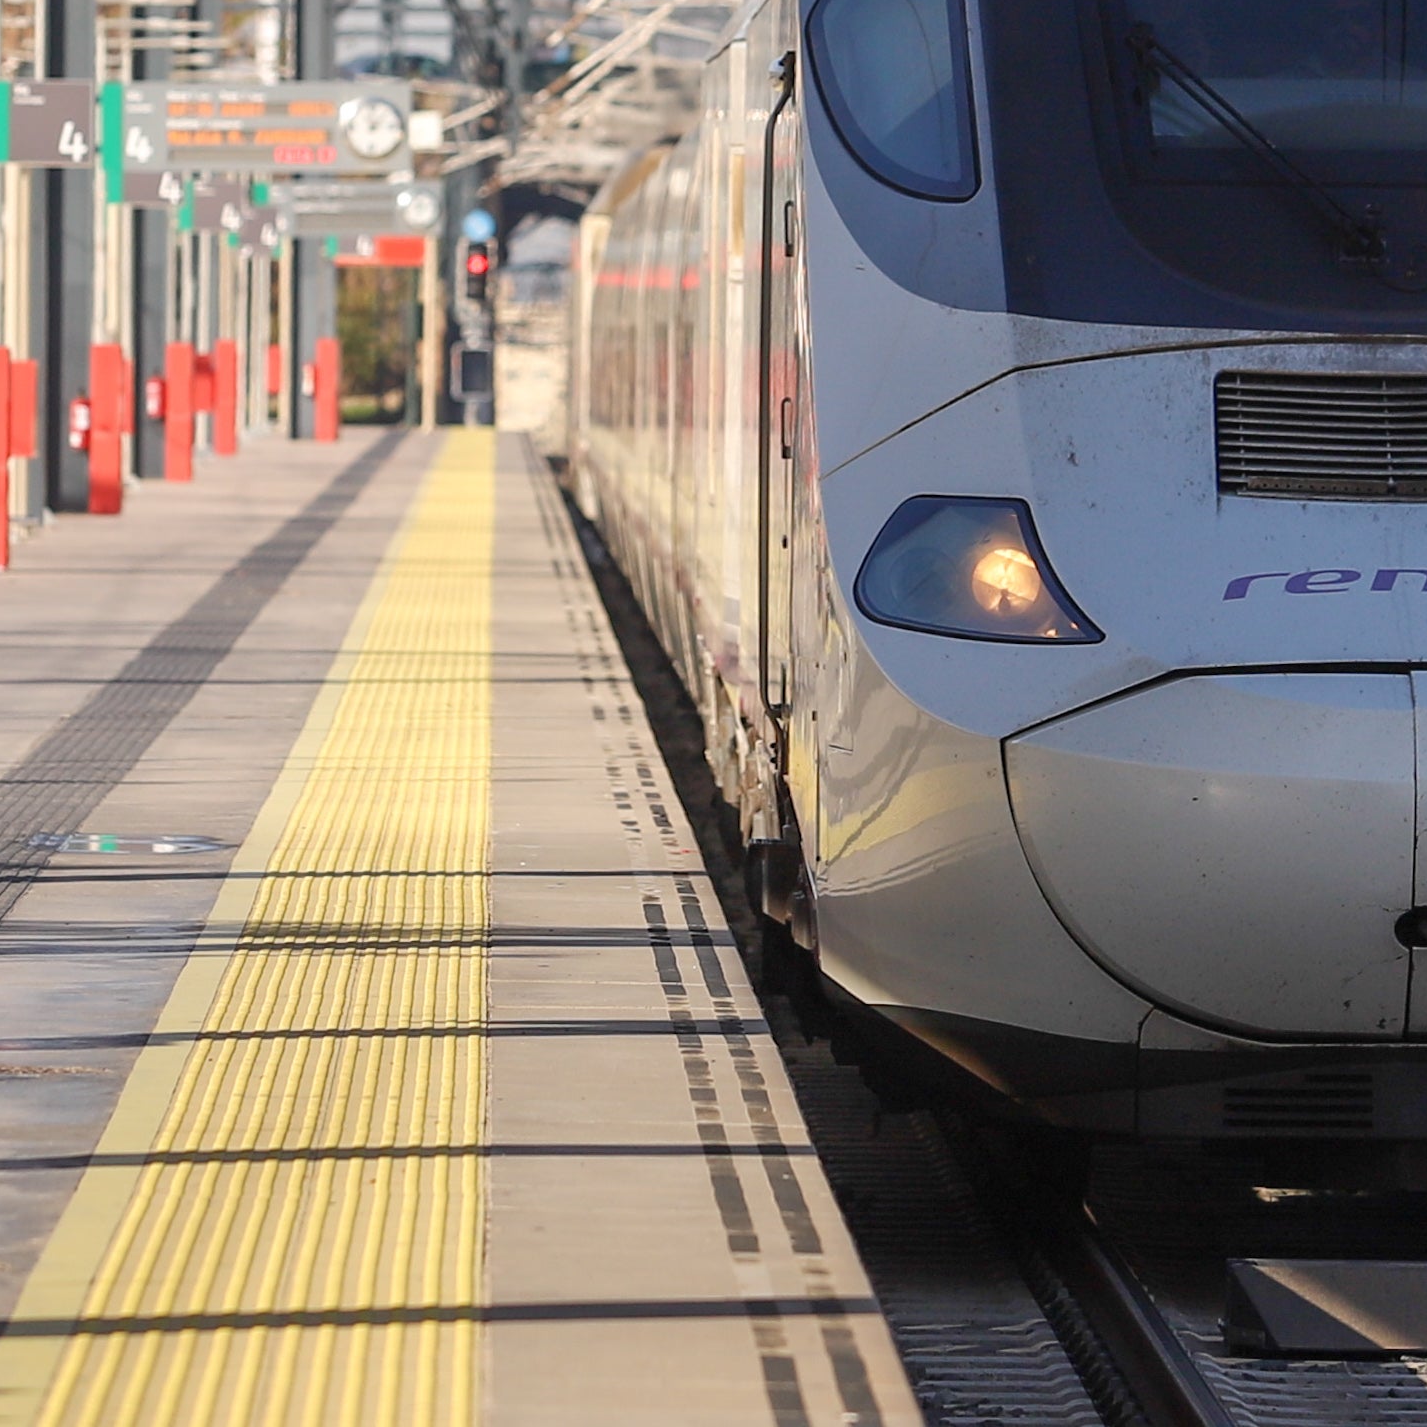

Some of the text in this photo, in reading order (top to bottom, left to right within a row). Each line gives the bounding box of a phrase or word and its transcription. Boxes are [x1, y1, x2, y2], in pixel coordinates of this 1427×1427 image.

[58, 120, 88, 163] 4
[125, 126, 153, 163] 4
[159, 171, 184, 205] 4
